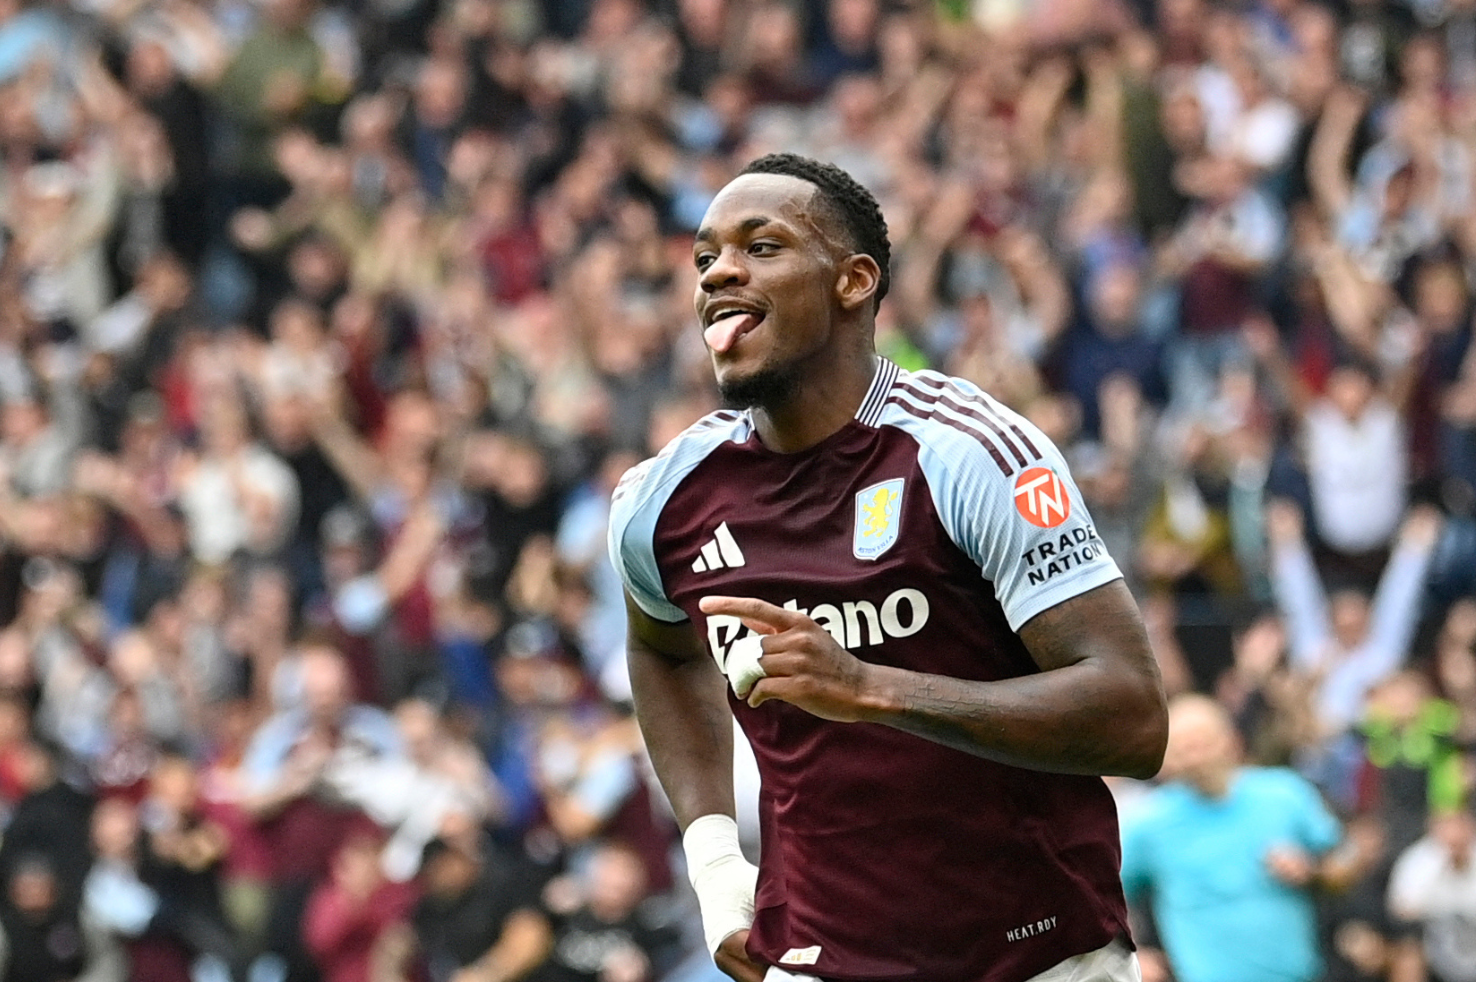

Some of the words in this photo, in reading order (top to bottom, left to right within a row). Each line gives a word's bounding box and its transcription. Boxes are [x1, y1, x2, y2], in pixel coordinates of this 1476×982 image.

[1022, 524, 1097, 566] TRADE
[1027, 544, 1103, 586] NATION
[1006, 915, 1057, 942] HEAT.RDY
